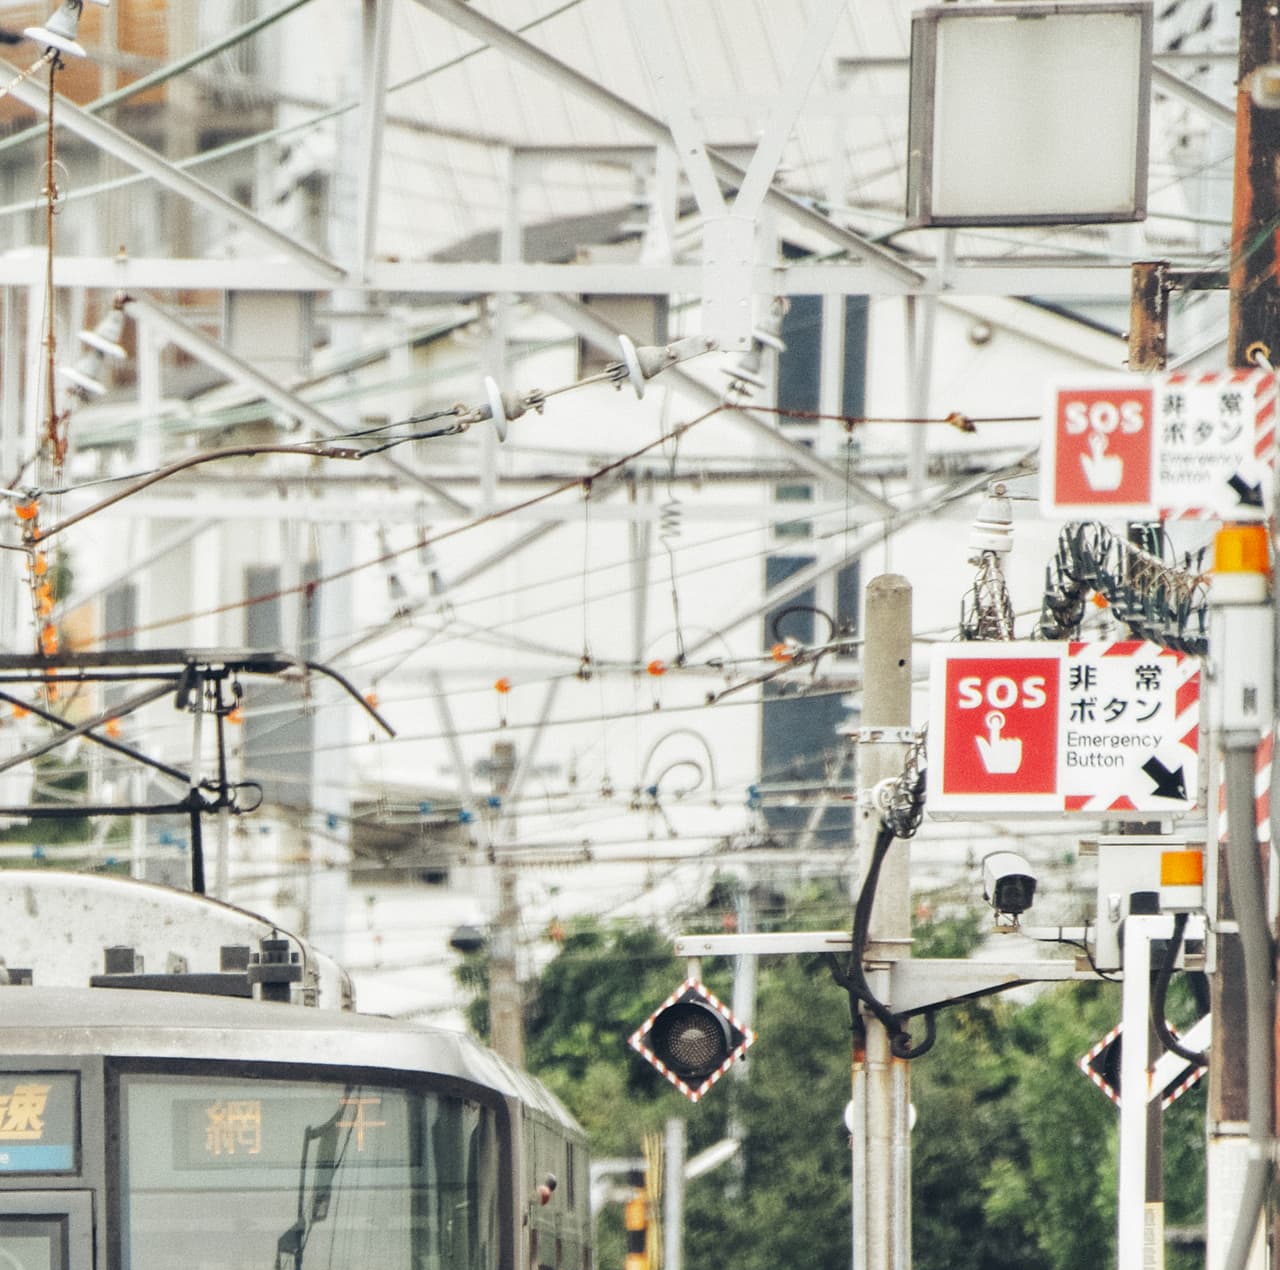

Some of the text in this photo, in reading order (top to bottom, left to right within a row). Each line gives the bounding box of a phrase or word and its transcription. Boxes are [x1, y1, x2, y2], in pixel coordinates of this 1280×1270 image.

[1065, 401, 1144, 435] SOS
[1163, 393, 1242, 417] 非常
[1164, 421, 1243, 444] ボタン
[1069, 664, 1162, 691] 非常
[958, 676, 1047, 709] SOS
[1069, 696, 1162, 723] ボタン
[1067, 731, 1163, 749] Emergency
[1066, 751, 1125, 768] Button
[206, 1096, 386, 1155] 網干
